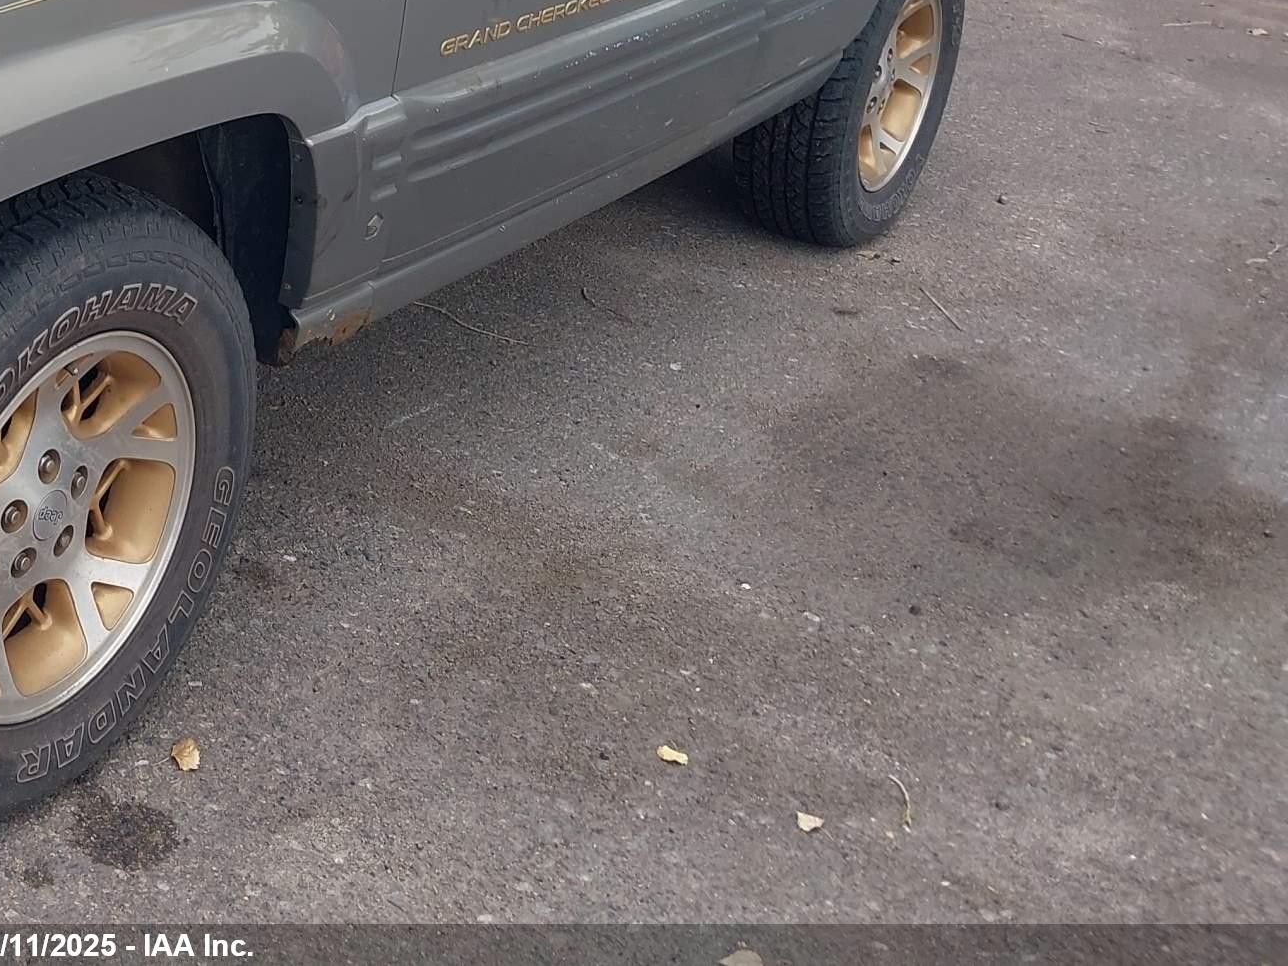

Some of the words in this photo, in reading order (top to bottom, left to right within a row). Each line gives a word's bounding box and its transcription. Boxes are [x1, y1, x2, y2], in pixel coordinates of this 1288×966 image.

[439, 21, 513, 57] GRAND
[38, 506, 64, 525] Jeep
[15, 465, 236, 785] GEOLANDAR
